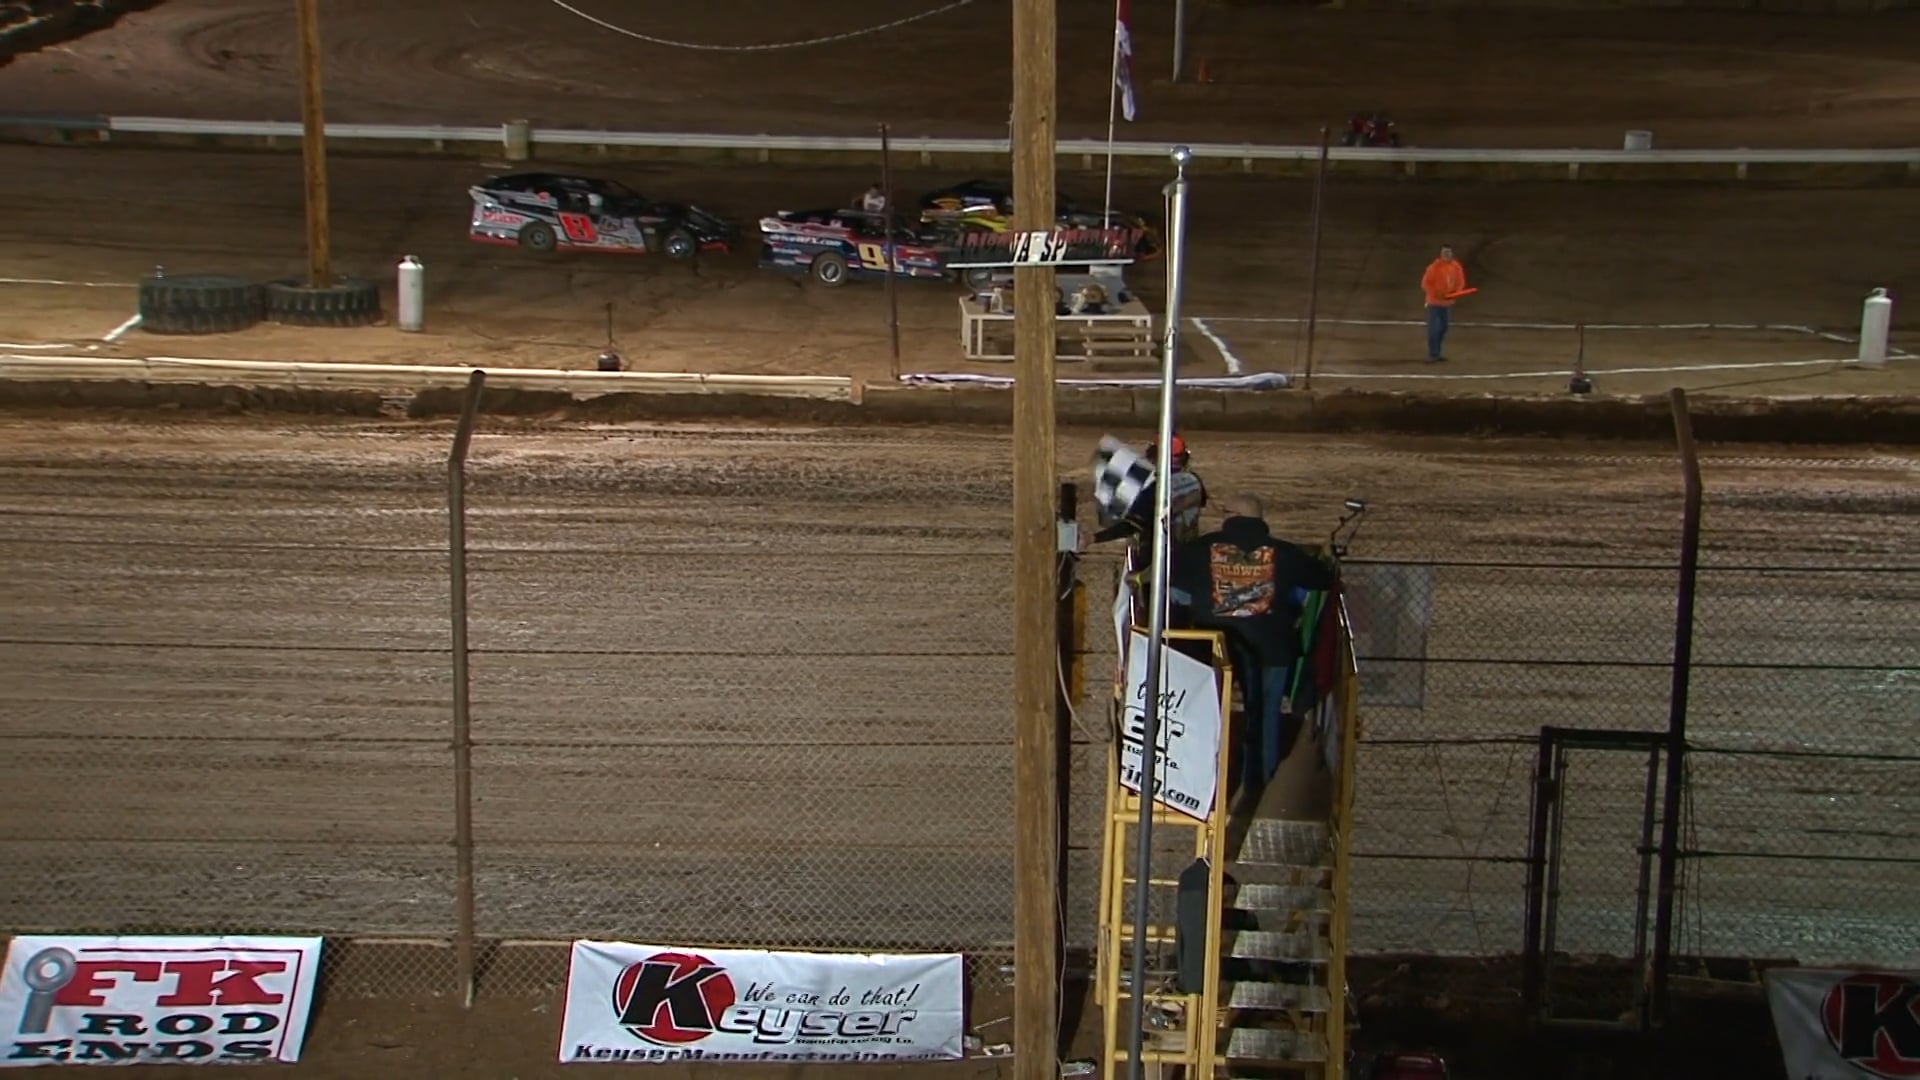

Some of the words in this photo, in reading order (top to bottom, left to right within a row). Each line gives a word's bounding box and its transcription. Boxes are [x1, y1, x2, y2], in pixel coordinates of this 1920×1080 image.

[857, 243, 889, 272] 9
[52, 960, 286, 1006] FK
[744, 981, 776, 1002] We
[786, 993, 821, 1006] can
[828, 986, 850, 1006] do
[861, 983, 920, 1008] that!
[78, 1013, 280, 1035] ROD
[8, 1039, 273, 1060] ENDS
